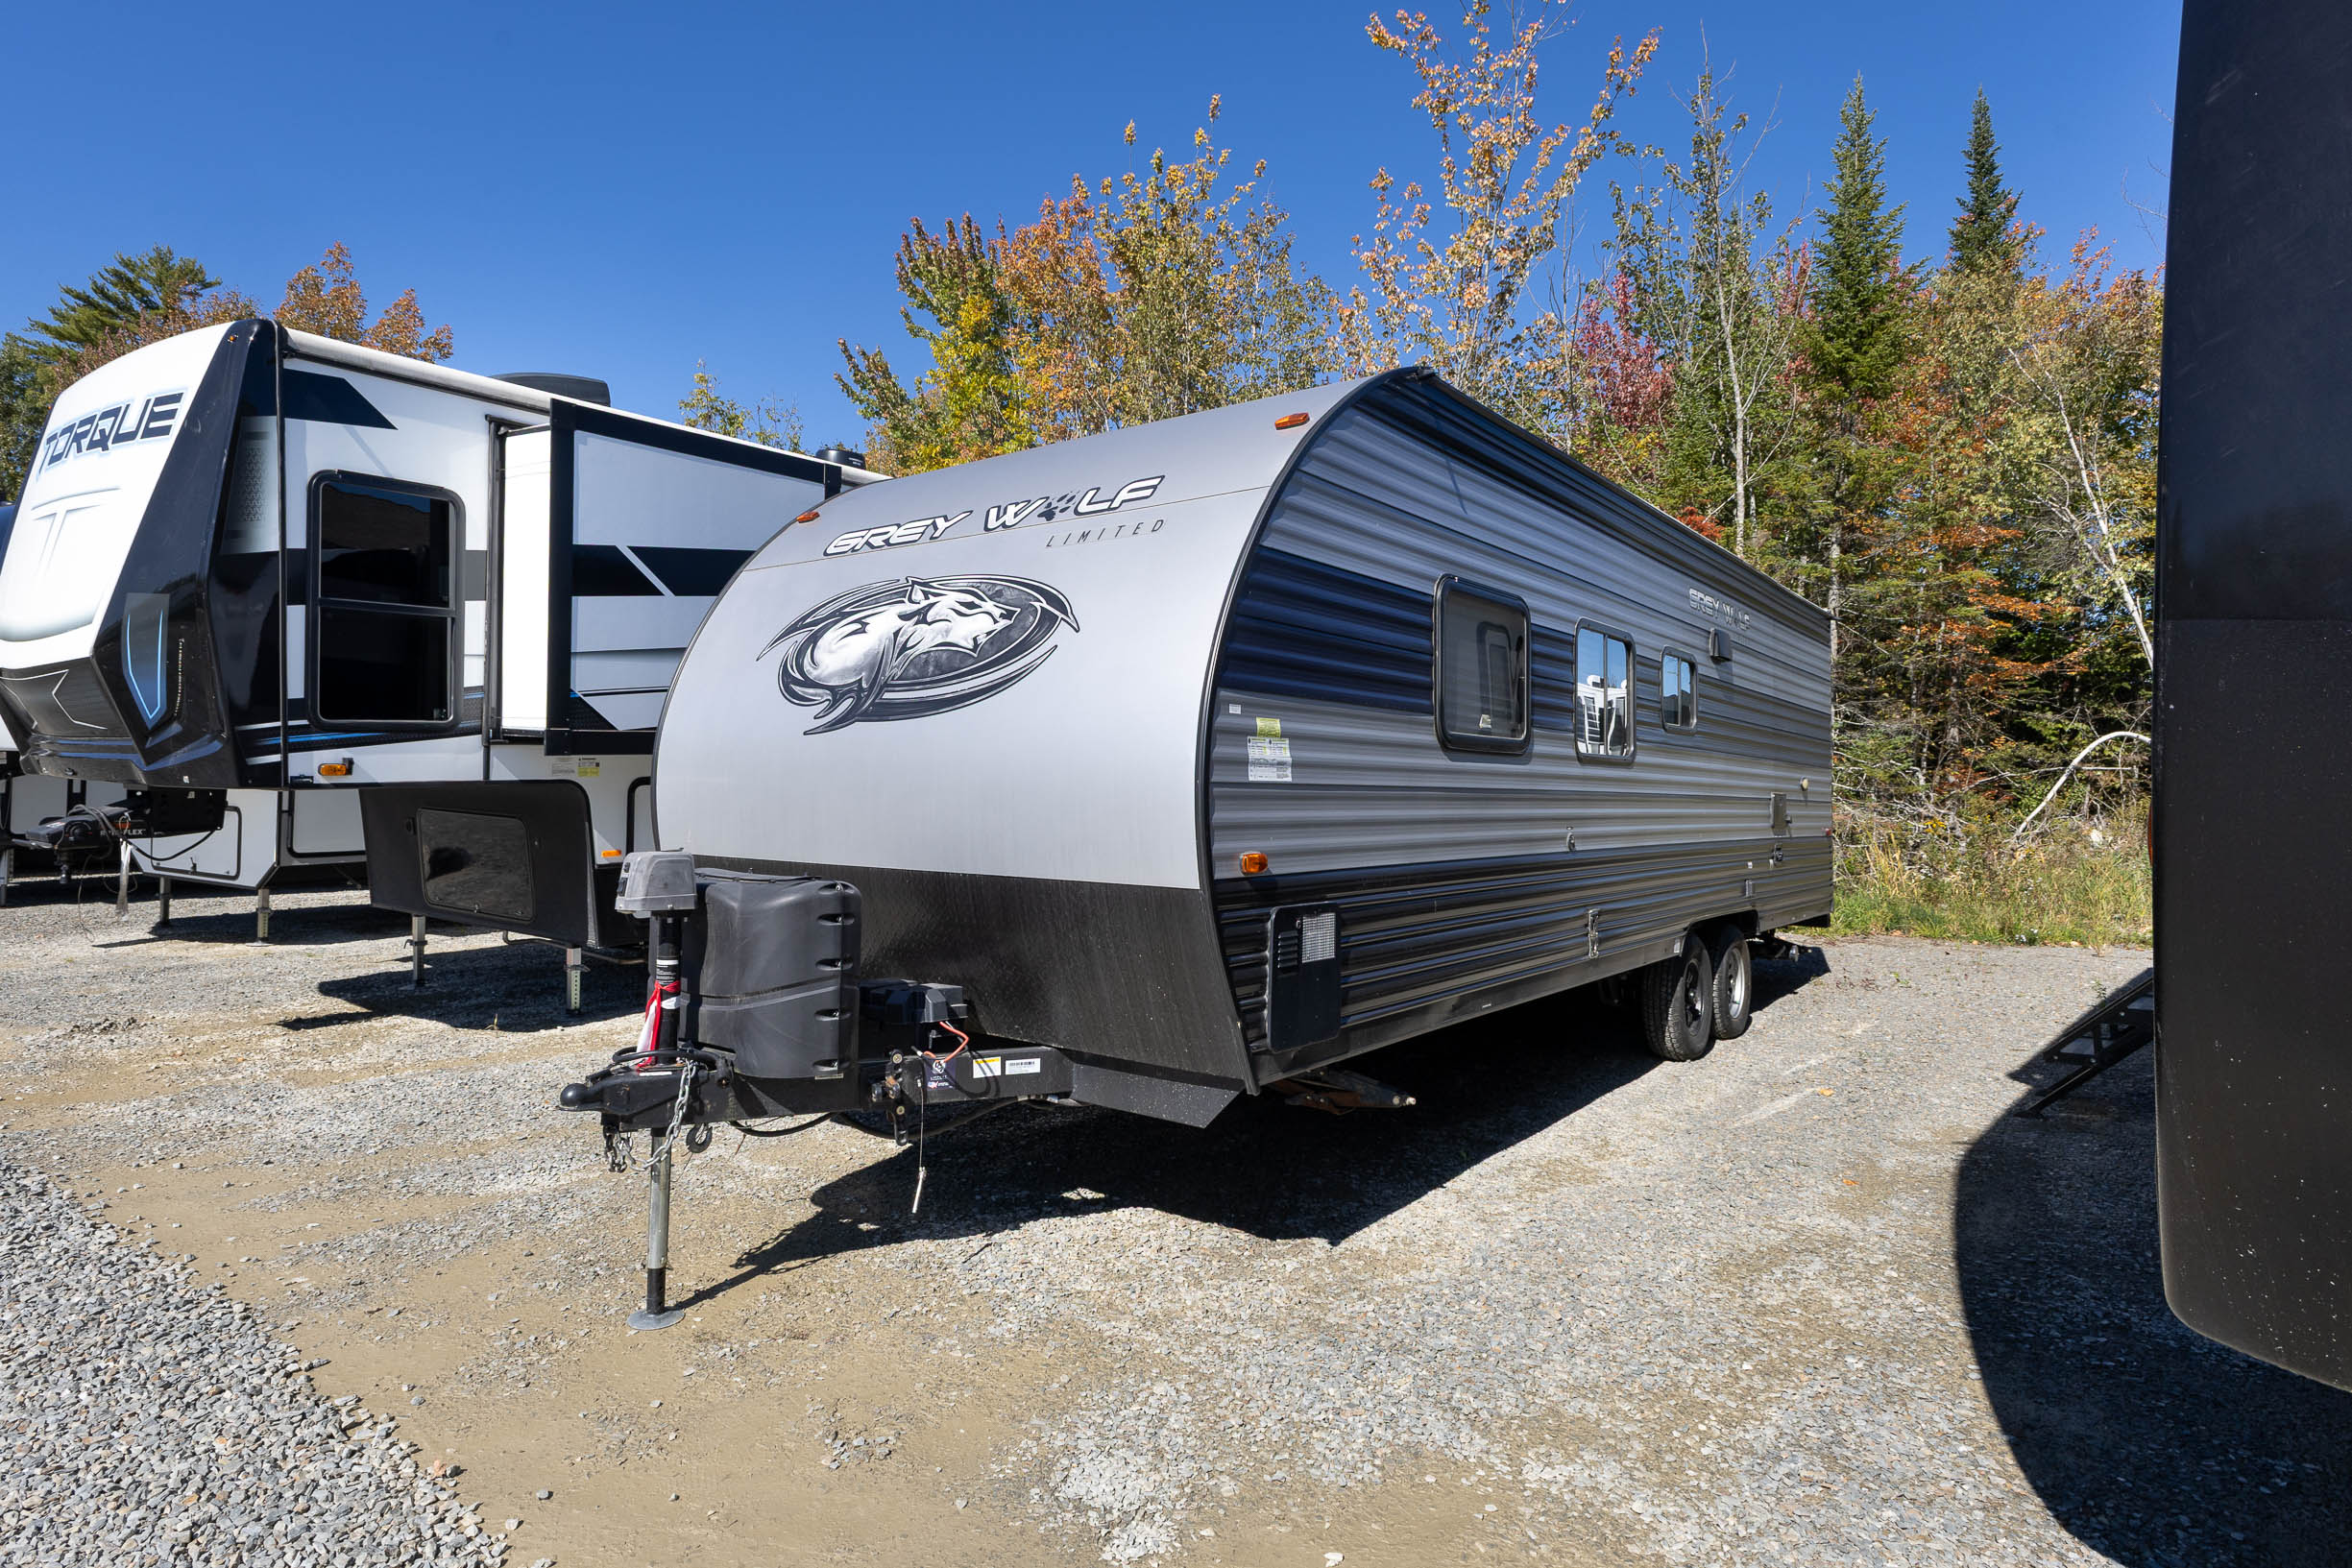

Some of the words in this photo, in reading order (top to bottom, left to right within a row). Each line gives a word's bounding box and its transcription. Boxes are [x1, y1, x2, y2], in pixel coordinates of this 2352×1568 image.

[38, 392, 184, 475] TORQUE
[823, 510, 974, 557] GREY
[1045, 519, 1165, 548] LIMITED
[1688, 588, 1720, 619] GREY
